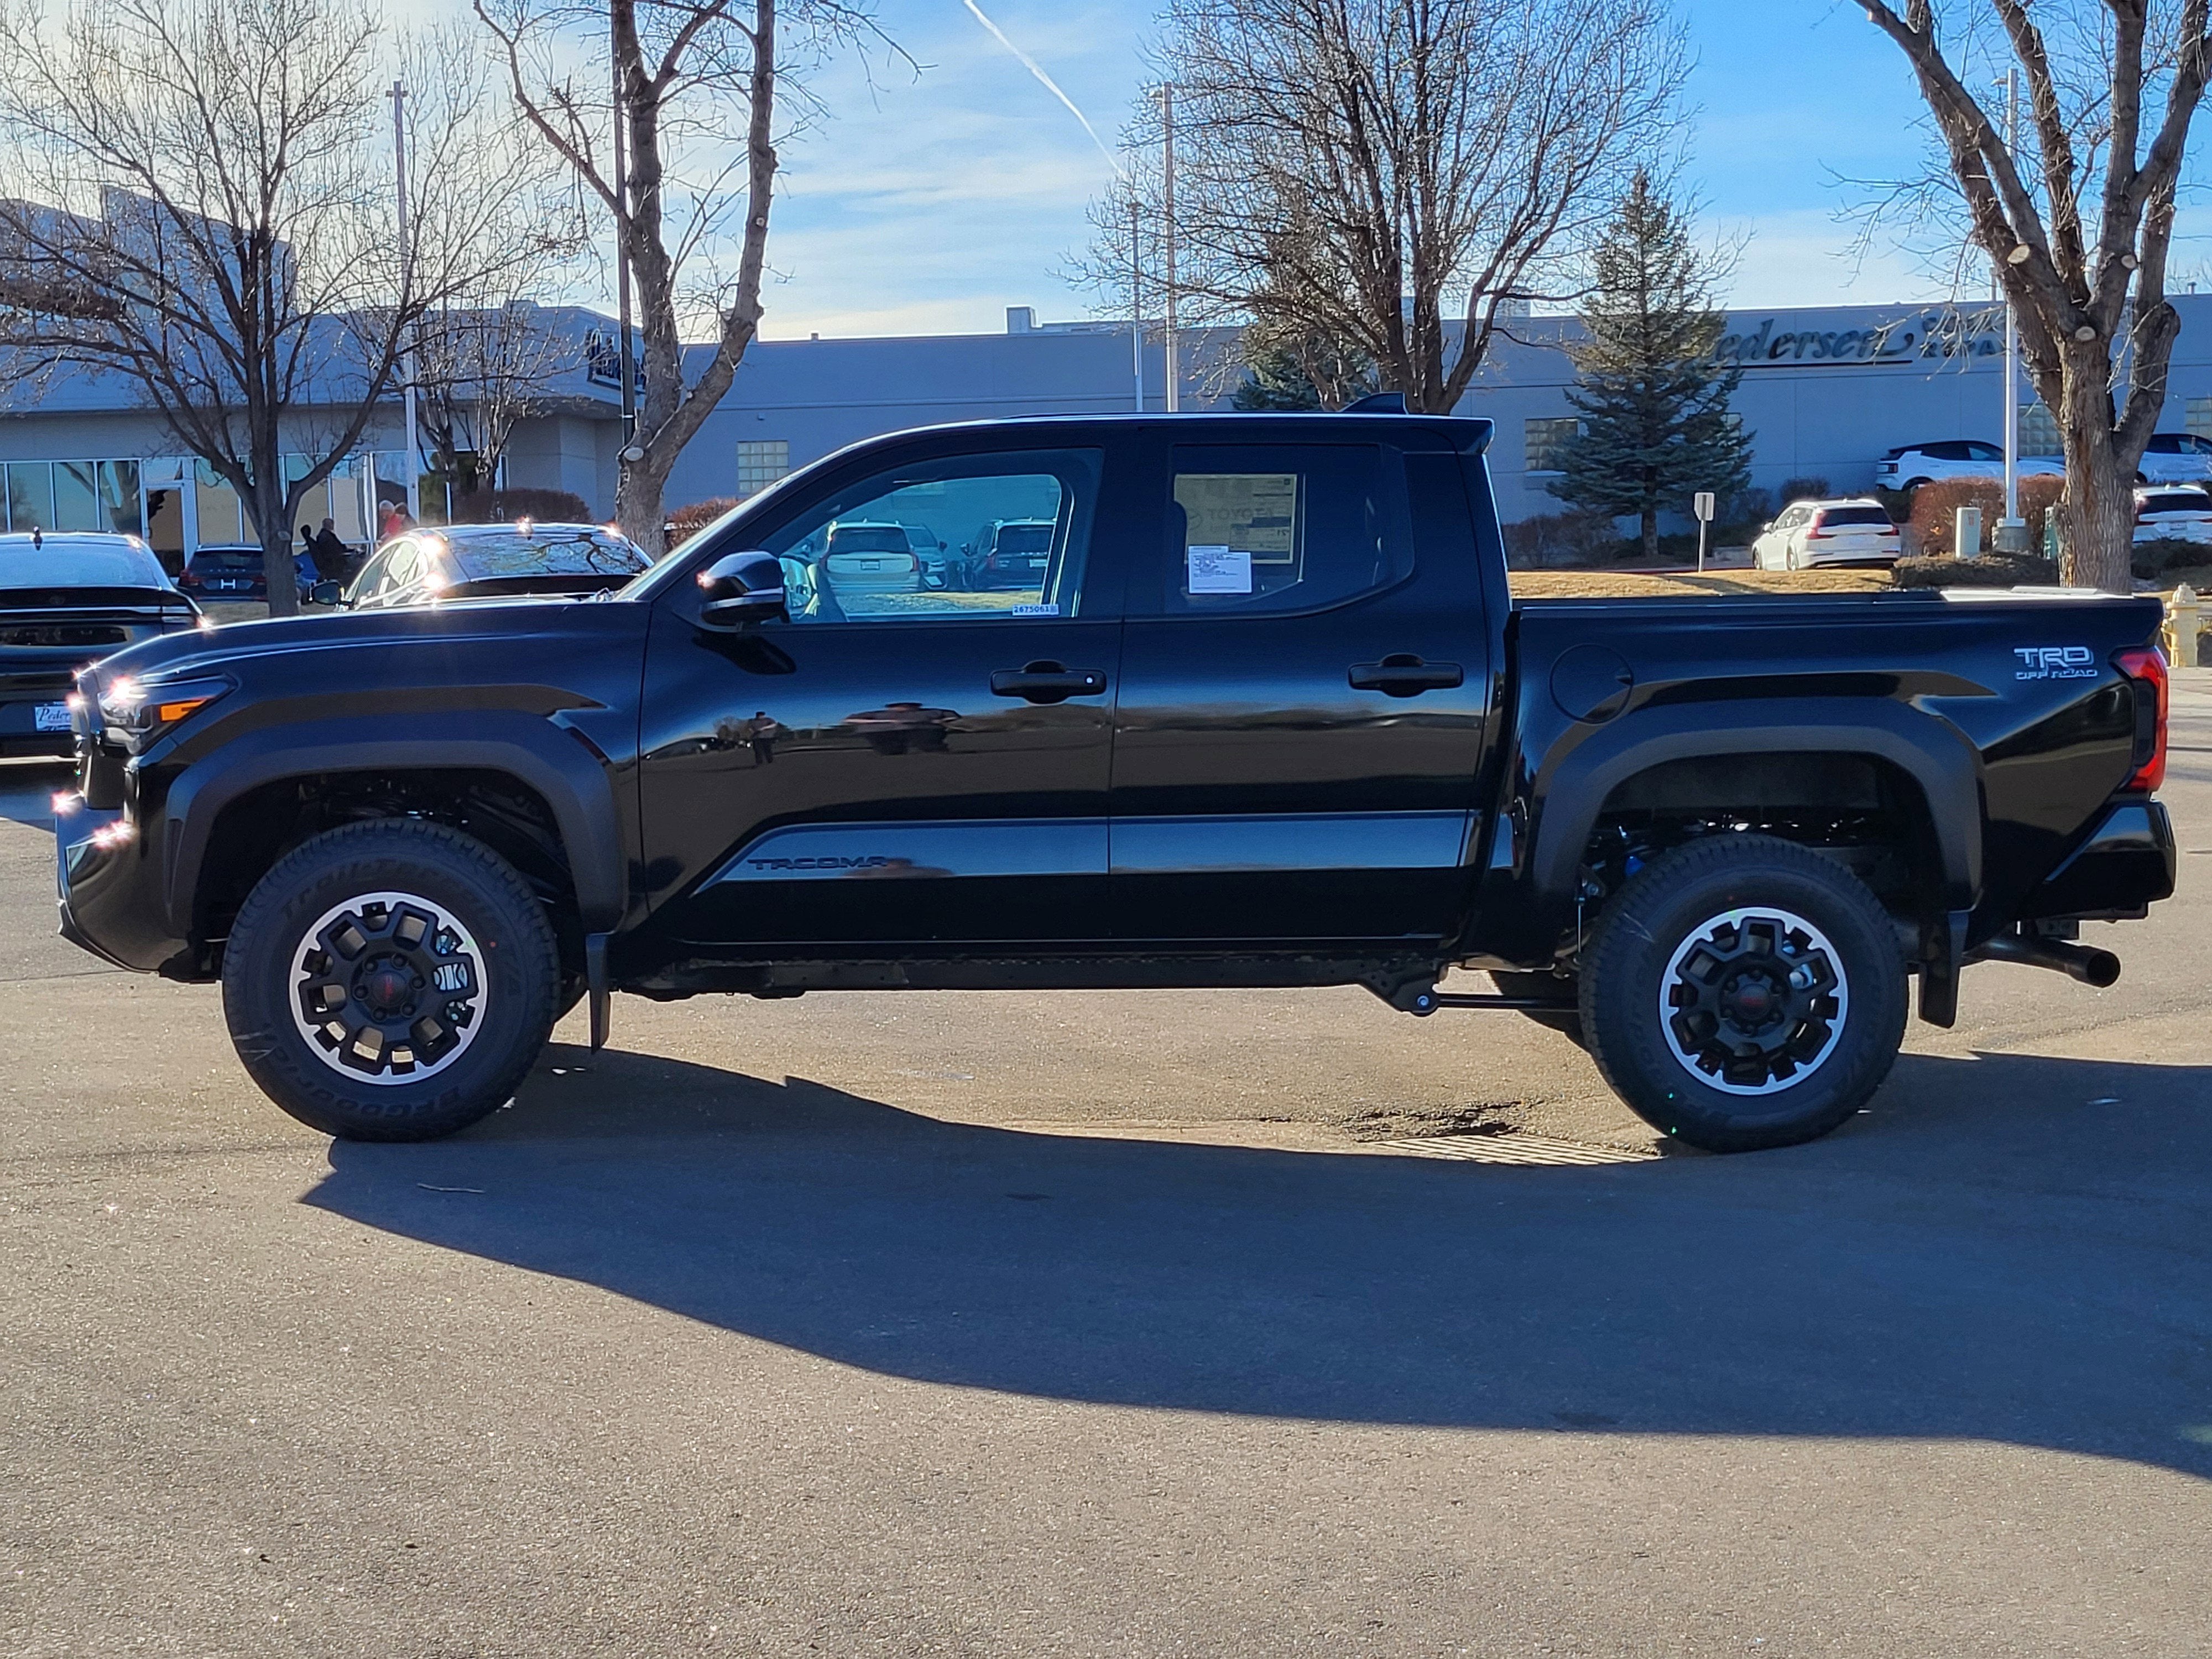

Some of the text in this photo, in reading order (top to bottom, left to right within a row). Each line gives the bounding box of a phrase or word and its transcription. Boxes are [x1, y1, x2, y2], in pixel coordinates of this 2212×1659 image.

[1714, 319, 1914, 362] edersen
[2013, 646, 2094, 669] TRD
[38, 708, 71, 722] Peder
[747, 855, 888, 870] TACOMA
